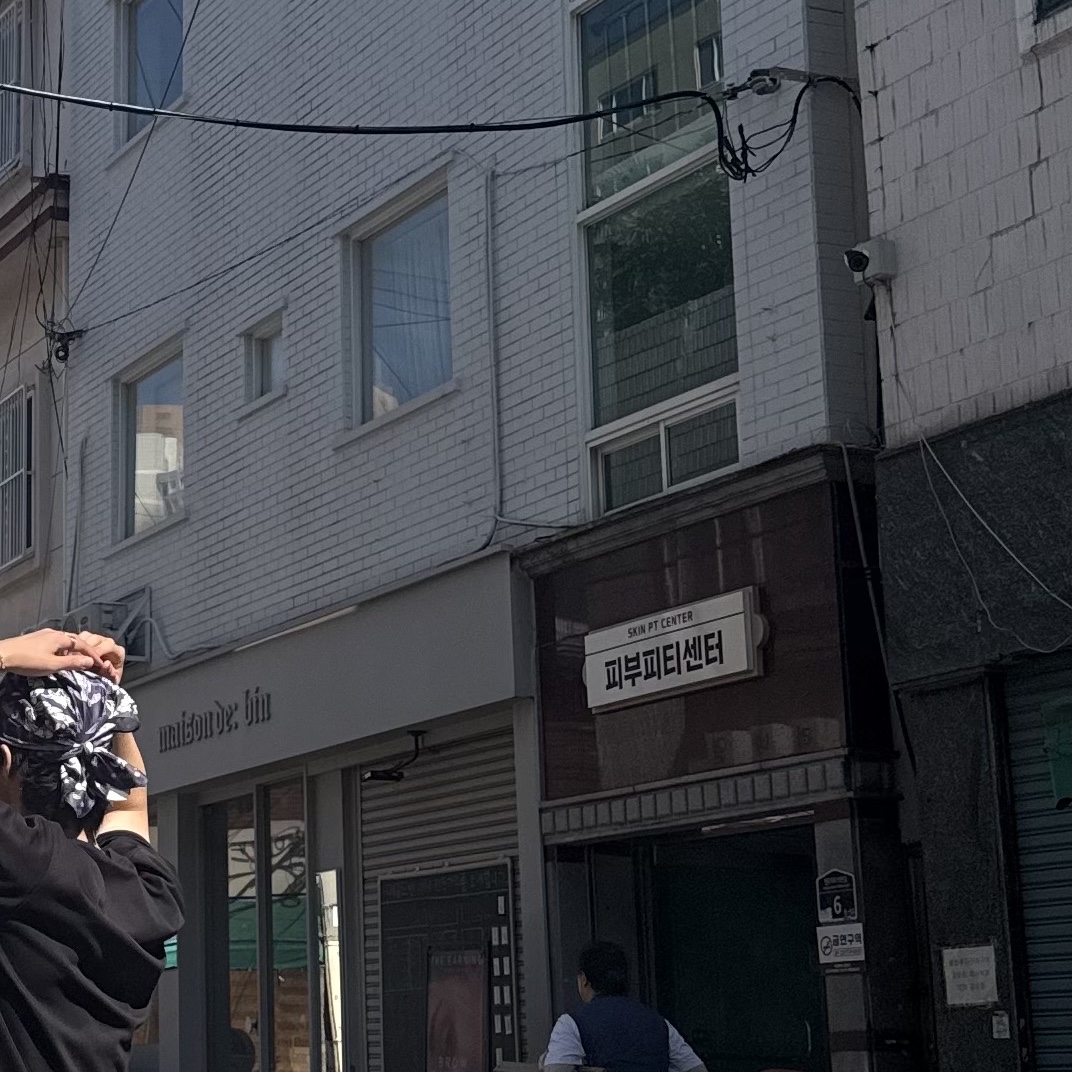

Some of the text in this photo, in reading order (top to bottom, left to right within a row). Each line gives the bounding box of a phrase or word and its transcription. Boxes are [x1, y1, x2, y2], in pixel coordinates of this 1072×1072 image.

[627, 610, 694, 639] SKIN PT CENTER
[604, 629, 724, 691] 피부피티센터
[159, 710, 214, 753] maison
[833, 895, 842, 915] 6
[832, 933, 862, 947] 금연구역
